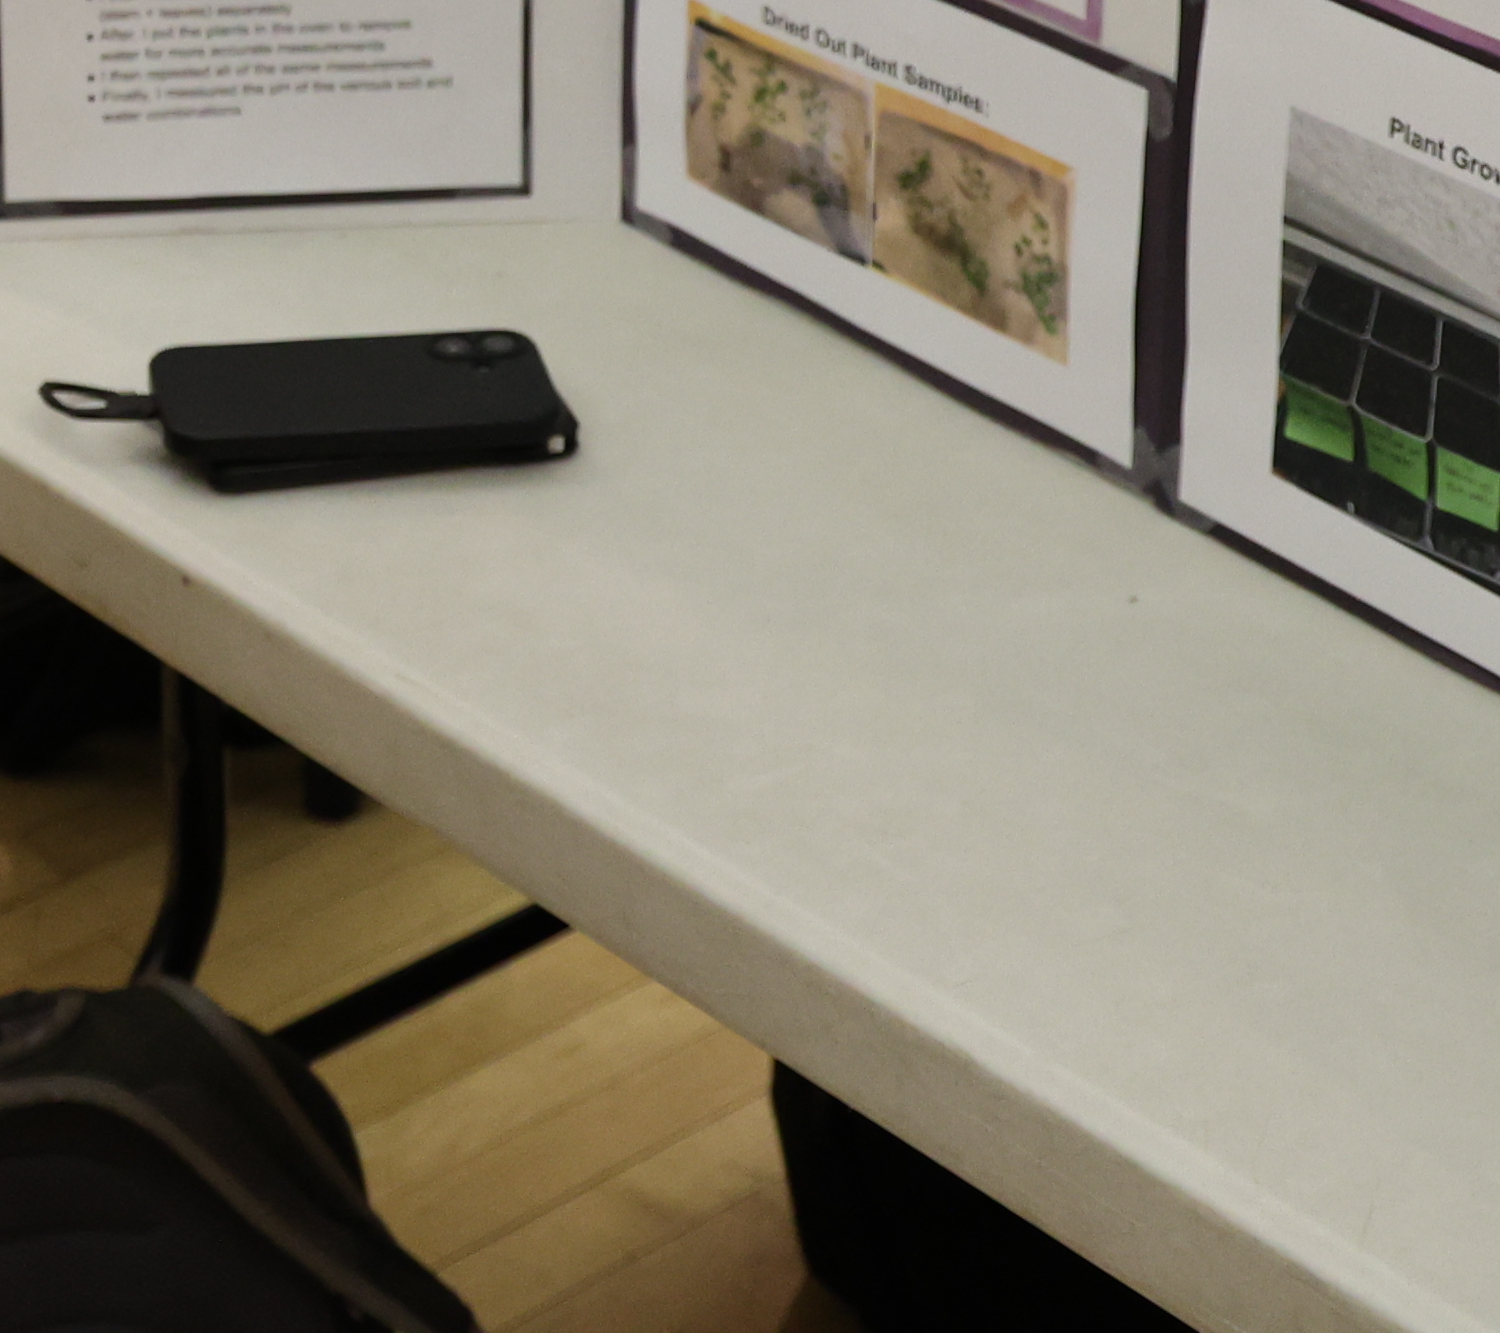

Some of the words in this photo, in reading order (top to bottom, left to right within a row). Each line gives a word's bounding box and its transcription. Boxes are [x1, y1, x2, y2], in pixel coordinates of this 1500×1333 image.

[763, 6, 810, 41] Dried
[814, 28, 846, 56] Out
[851, 42, 897, 78] Plant
[903, 64, 989, 117] Samples:
[1389, 117, 1445, 161] Plant
